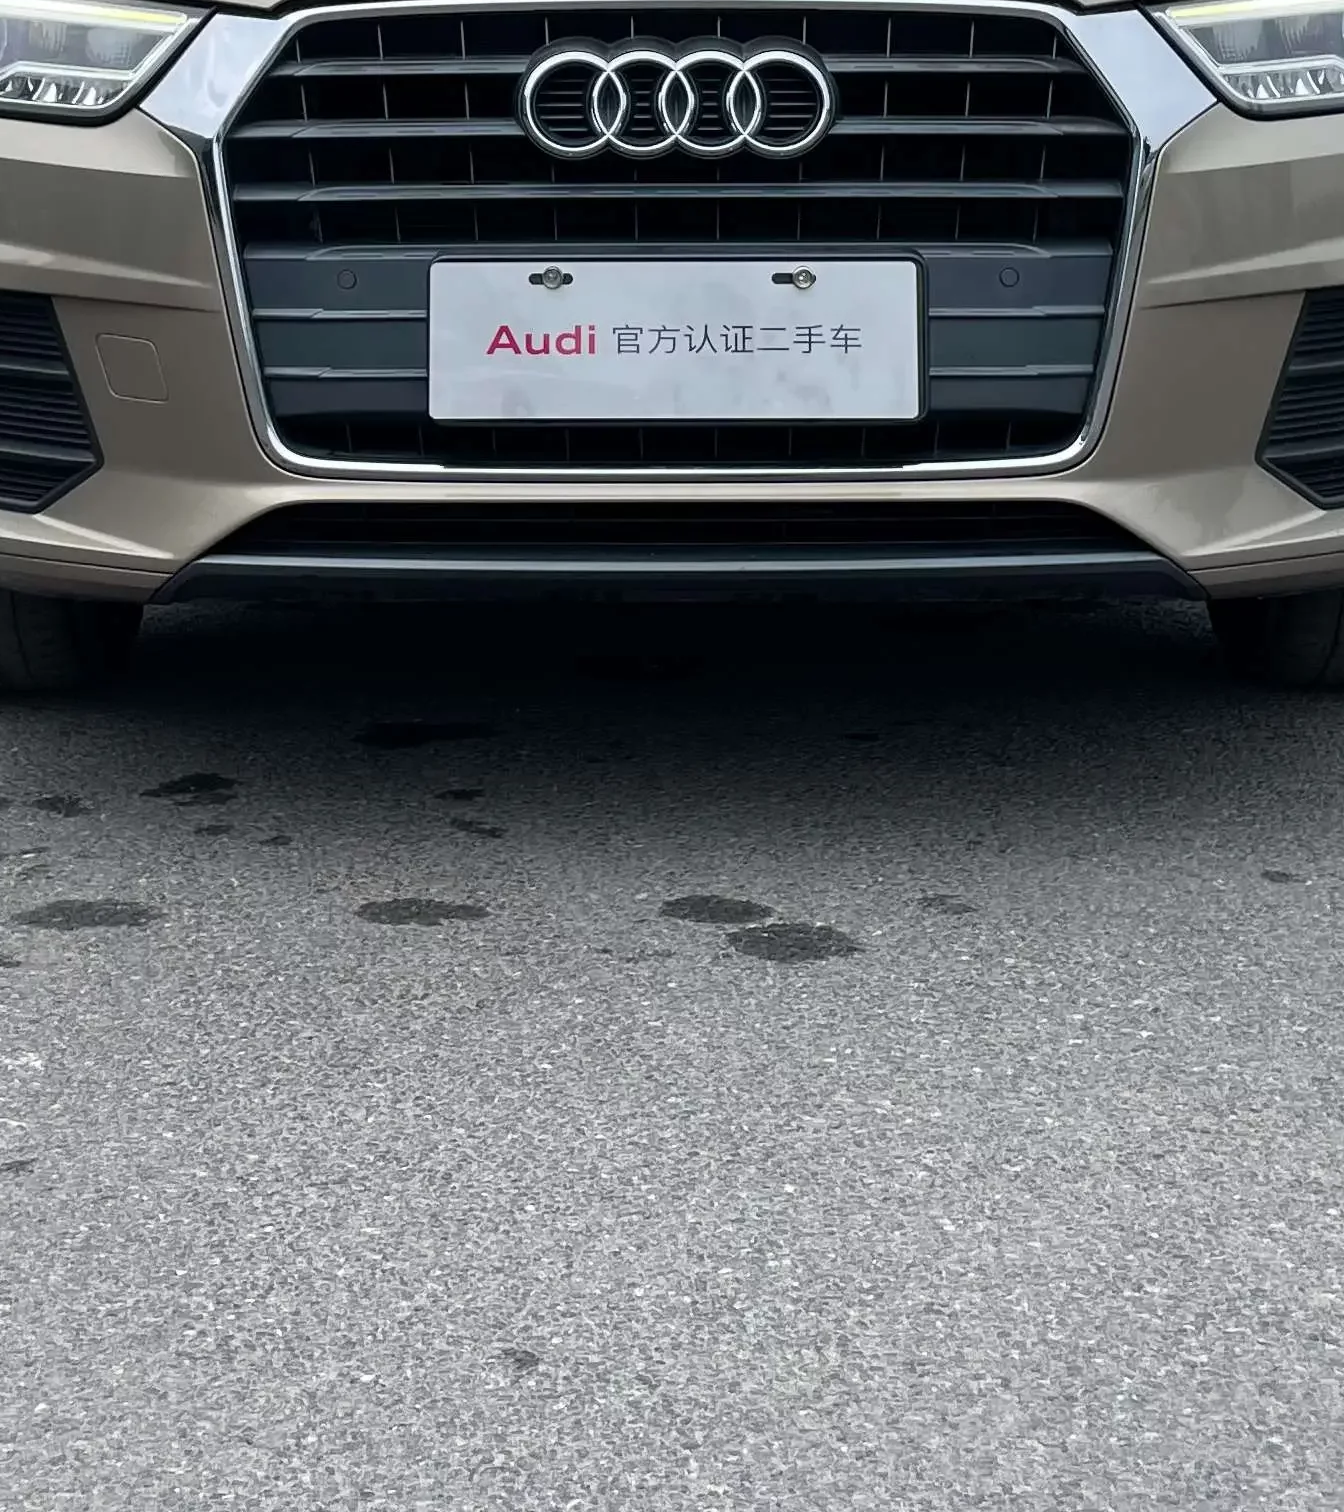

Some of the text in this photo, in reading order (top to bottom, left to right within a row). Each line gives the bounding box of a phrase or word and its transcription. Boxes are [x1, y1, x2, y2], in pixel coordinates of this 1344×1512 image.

[486, 323, 862, 356] Audi 官方认证二手车
